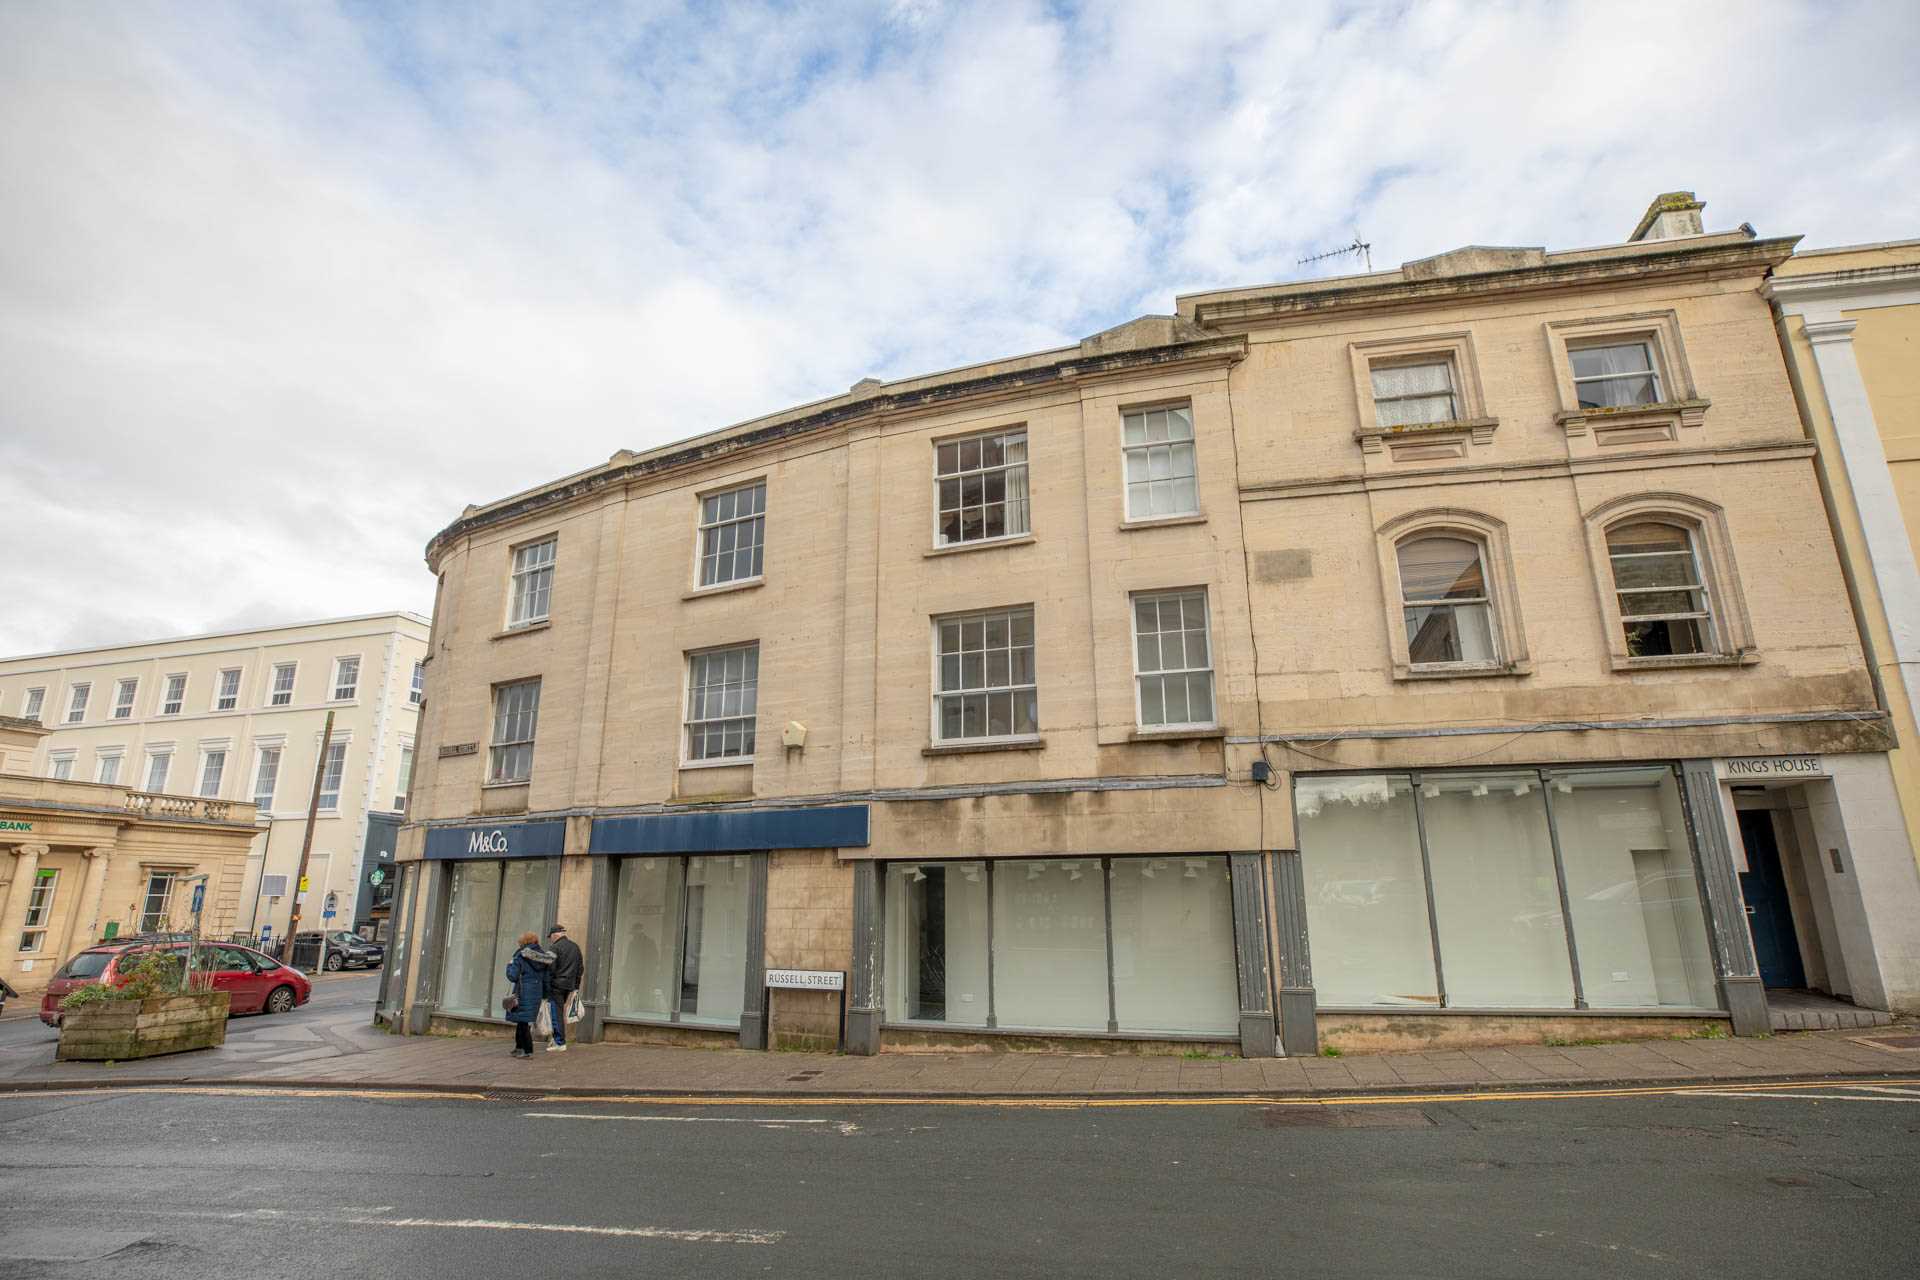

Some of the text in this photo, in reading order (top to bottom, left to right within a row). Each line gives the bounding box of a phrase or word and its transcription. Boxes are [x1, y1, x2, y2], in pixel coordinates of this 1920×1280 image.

[1727, 758, 1819, 774] KINGS HOUSE
[0, 821, 33, 831] BANK
[468, 830, 509, 853] M&Co.
[768, 973, 840, 986] RUSSELL STREET
